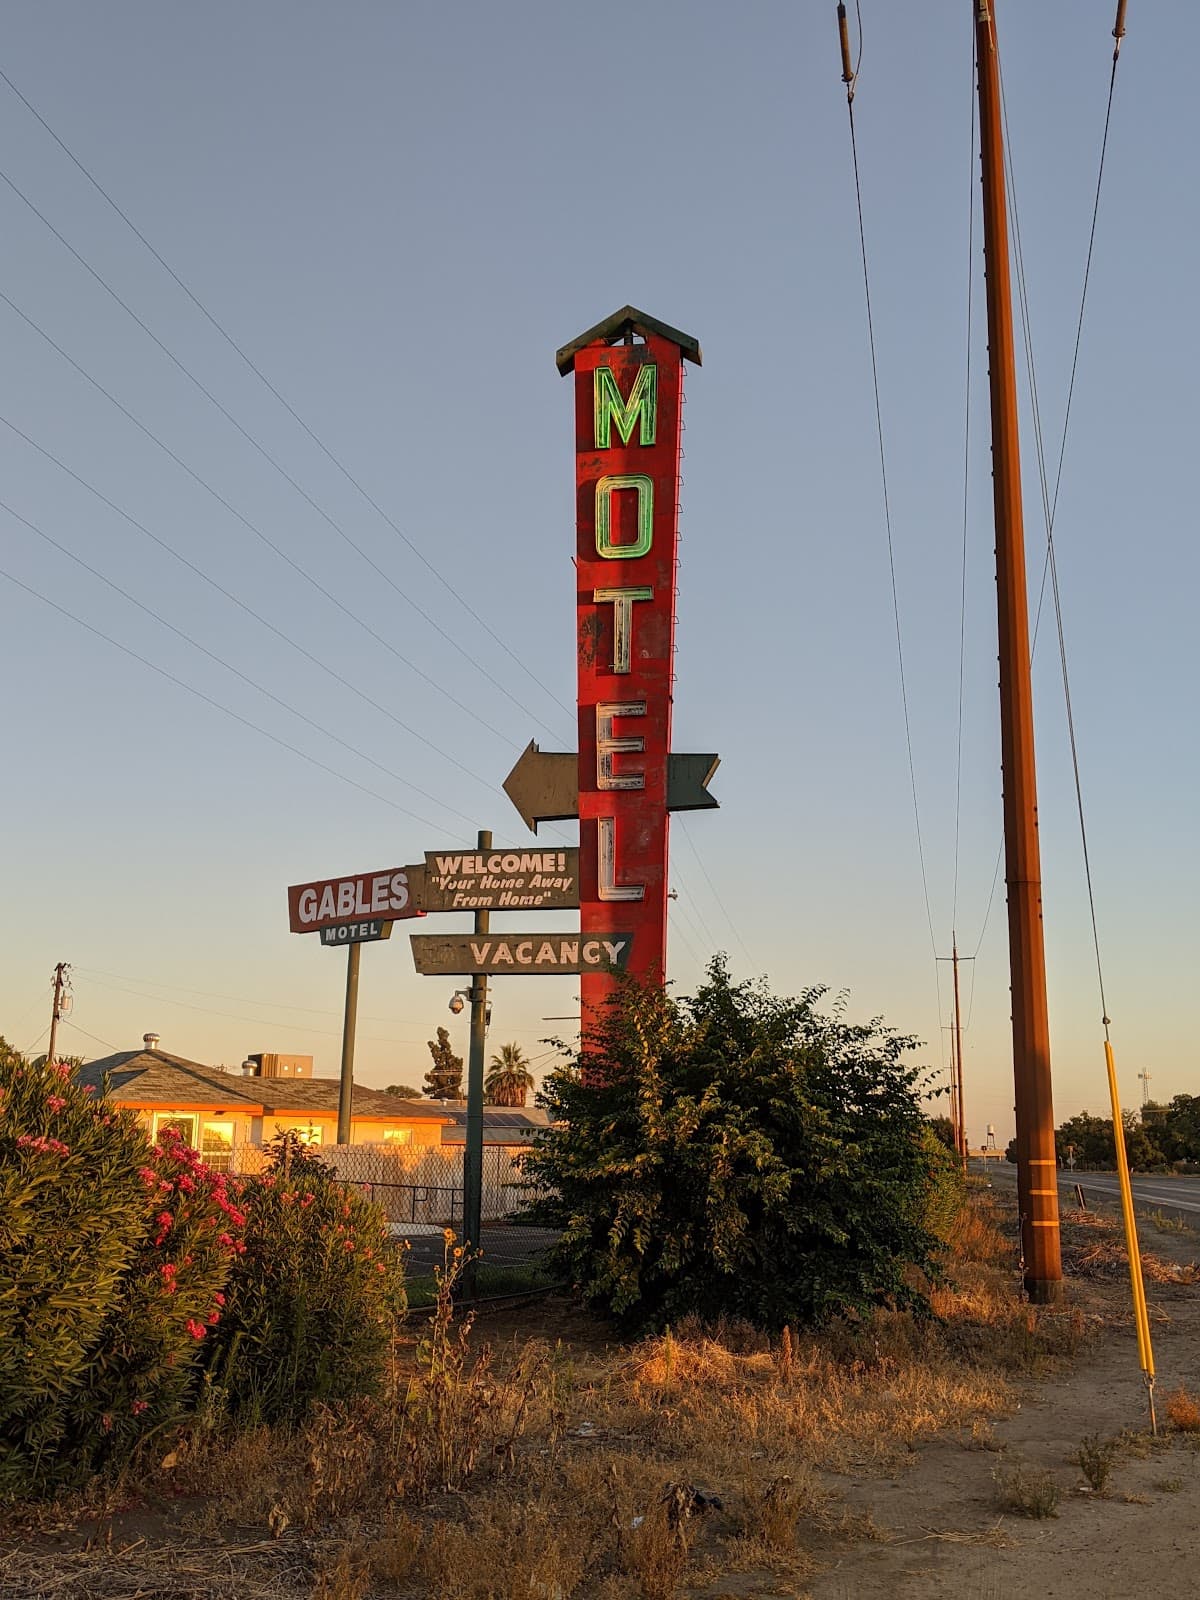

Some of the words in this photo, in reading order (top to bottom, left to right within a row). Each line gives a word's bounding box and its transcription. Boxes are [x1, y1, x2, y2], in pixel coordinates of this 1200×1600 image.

[593, 363, 657, 903] MOTEL
[435, 853, 566, 876] WELCOME!
[431, 875, 476, 890] "Your
[480, 876, 523, 889] Home
[529, 875, 573, 892] Away
[298, 871, 409, 924] GABLES
[452, 893, 493, 907] From
[498, 891, 551, 906] Home"
[325, 922, 378, 942] MOTEL
[470, 940, 627, 966] VACANCY
